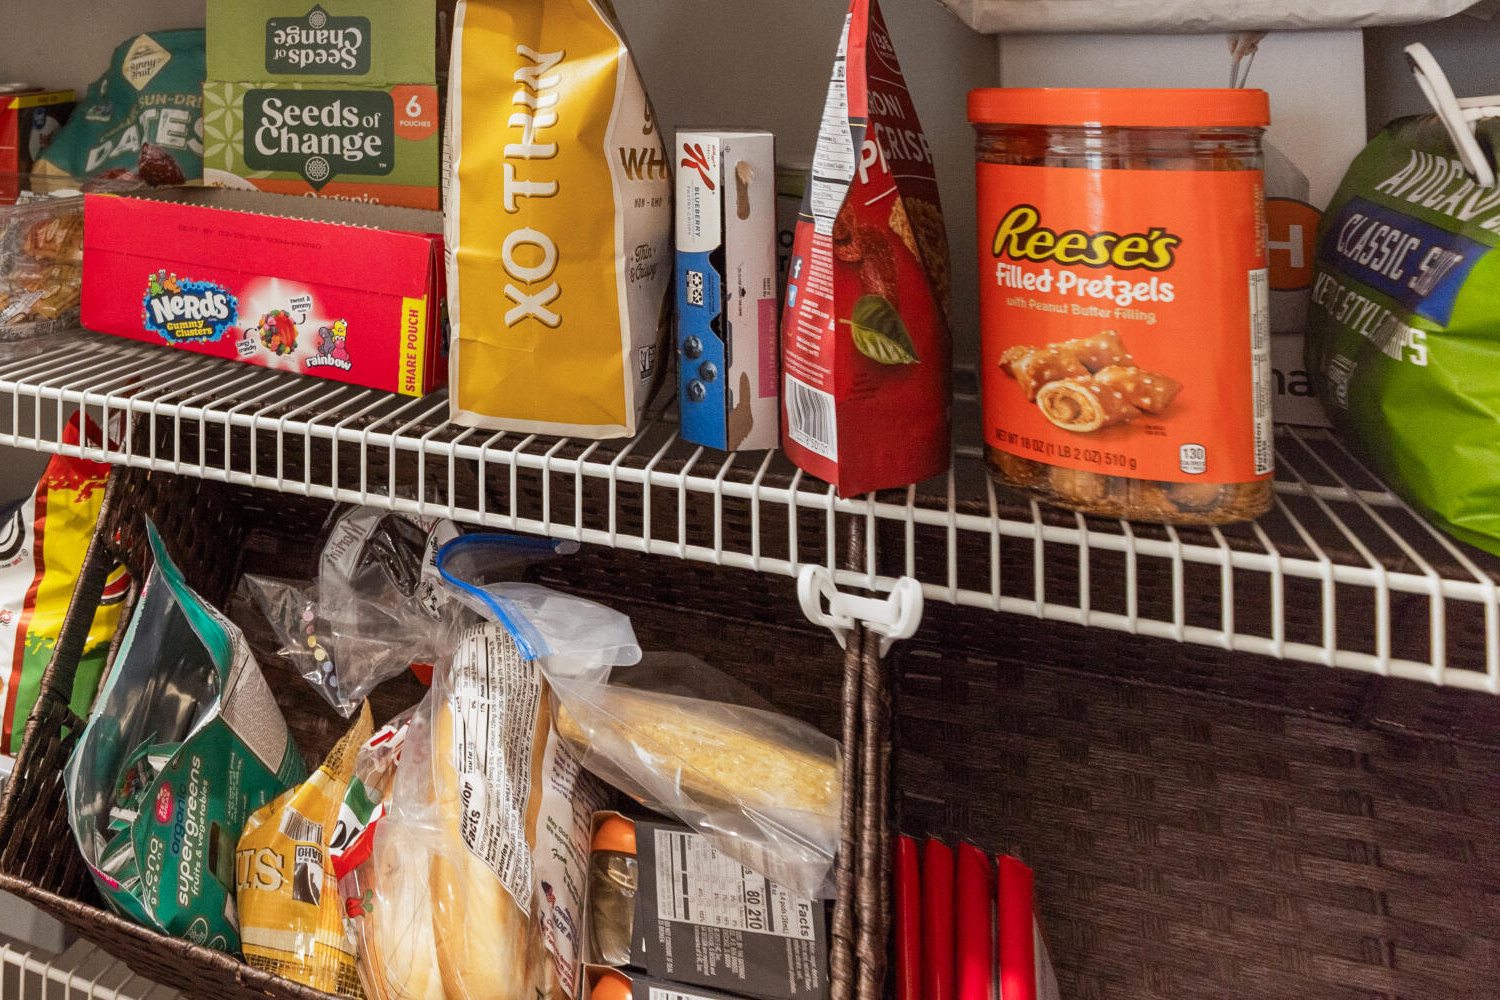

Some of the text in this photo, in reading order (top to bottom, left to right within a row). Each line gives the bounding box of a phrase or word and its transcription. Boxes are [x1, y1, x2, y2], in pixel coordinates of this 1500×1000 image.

[274, 25, 363, 50] Change
[273, 47, 358, 70] Seeds of
[261, 97, 381, 128] Seeds of
[406, 95, 422, 118] 6
[399, 119, 431, 128] POUCHES
[254, 125, 382, 161] Change
[681, 143, 715, 191] K
[501, 44, 566, 331] XO THIN
[635, 243, 652, 262] Thin
[993, 206, 1180, 269] Reese's
[1337, 213, 1421, 281] CLASSIC
[636, 262, 658, 281] Crispy
[996, 262, 1175, 307] Filled Pretzels
[291, 302, 311, 310] gummy
[1006, 297, 1157, 325] with Peanut Butter Filling
[166, 319, 204, 331] Gummy
[175, 326, 213, 338] Clusters
[306, 354, 352, 371] rainbow
[406, 308, 419, 393] SHARE POUCH
[996, 428, 1007, 443] NET
[1008, 433, 1018, 446] WT
[1033, 439, 1044, 453] OZ
[1046, 443, 1056, 458] (1
[1058, 446, 1071, 458] LB
[1074, 449, 1080, 460] 2
[1083, 450, 1101, 466] OZ)
[1105, 453, 1126, 467] 510
[1129, 457, 1137, 470] g
[1182, 447, 1203, 460] 130
[158, 788, 168, 816] ZERO
[162, 791, 173, 820] SUGAR
[171, 783, 187, 856] organic
[179, 755, 201, 906] supergreens
[466, 810, 481, 849] Facts
[191, 866, 201, 896] fruits
[198, 779, 210, 849] vegetables
[746, 890, 762, 930] 80 210
[797, 903, 811, 938] Facts
